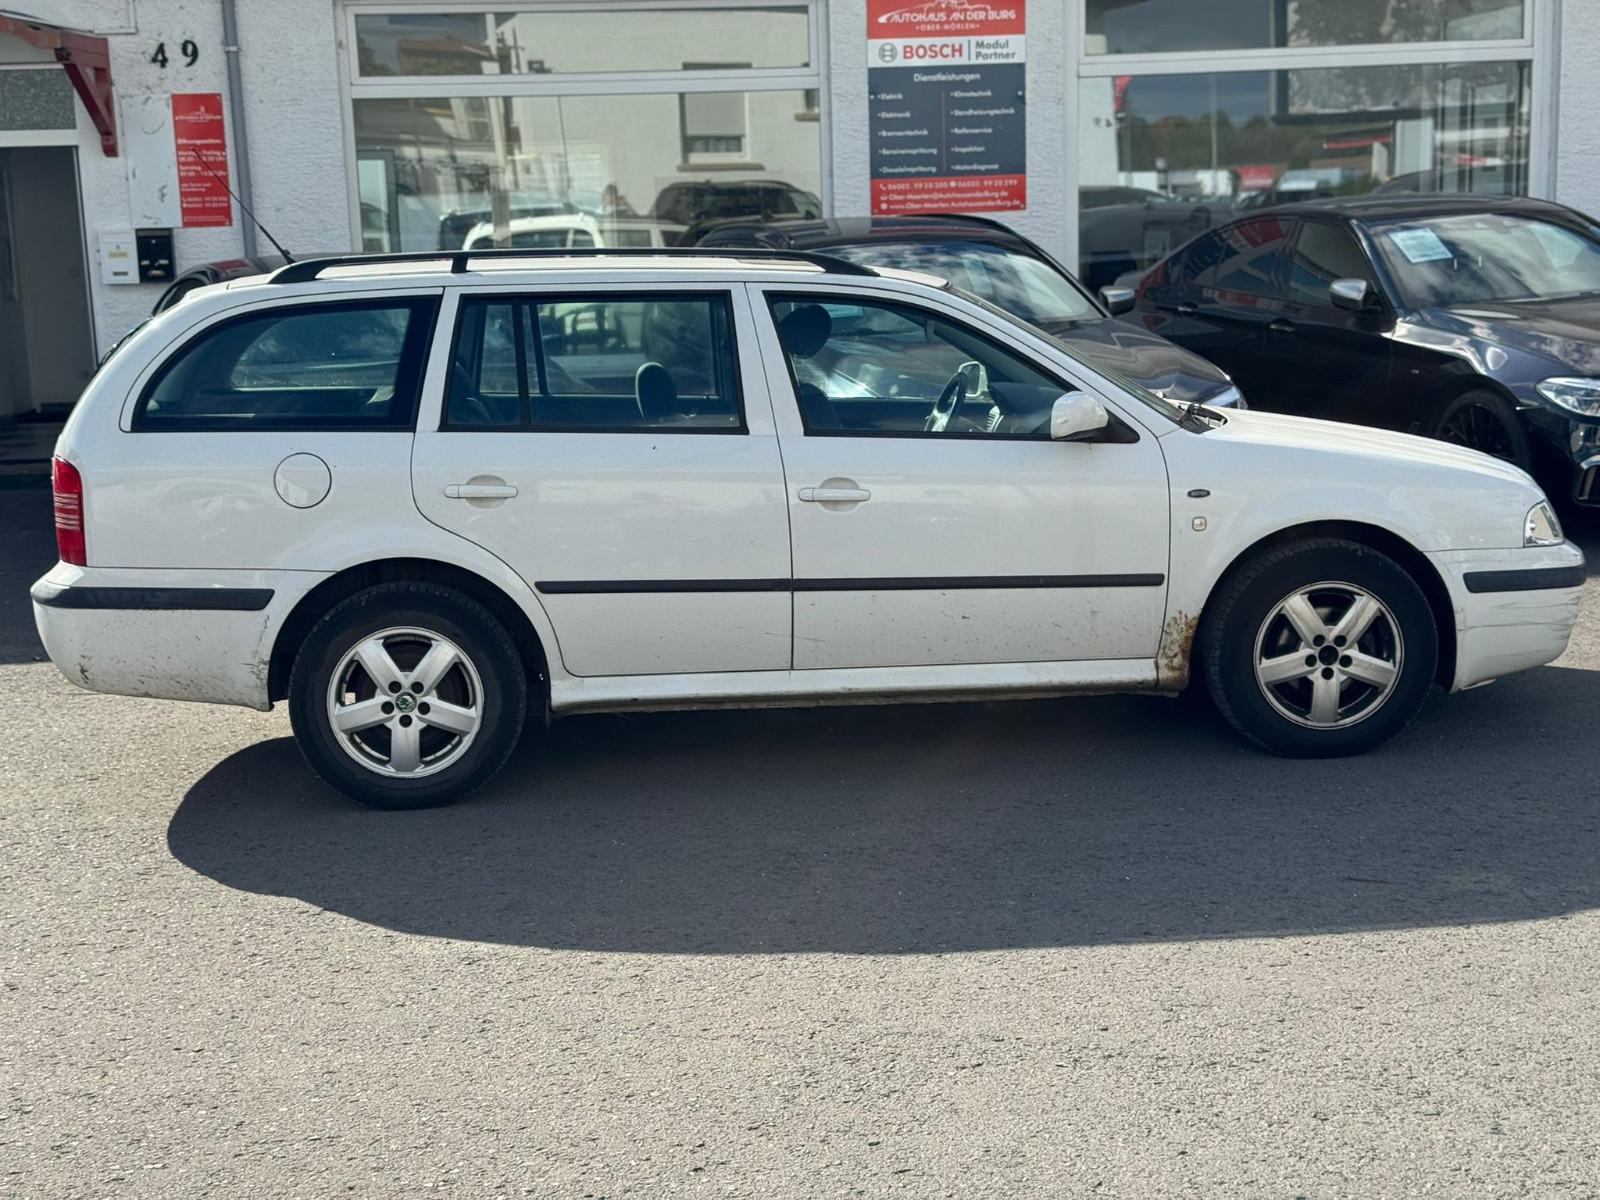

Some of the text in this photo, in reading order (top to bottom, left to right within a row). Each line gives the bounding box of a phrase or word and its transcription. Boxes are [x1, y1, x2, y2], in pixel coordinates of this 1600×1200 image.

[890, 9, 1016, 23] AUTOHAUS AN DER BURG
[975, 39, 1009, 50] Modul
[903, 43, 963, 60] BOSCH
[975, 51, 1016, 61] Partner
[913, 72, 981, 83] Dienstleistungen
